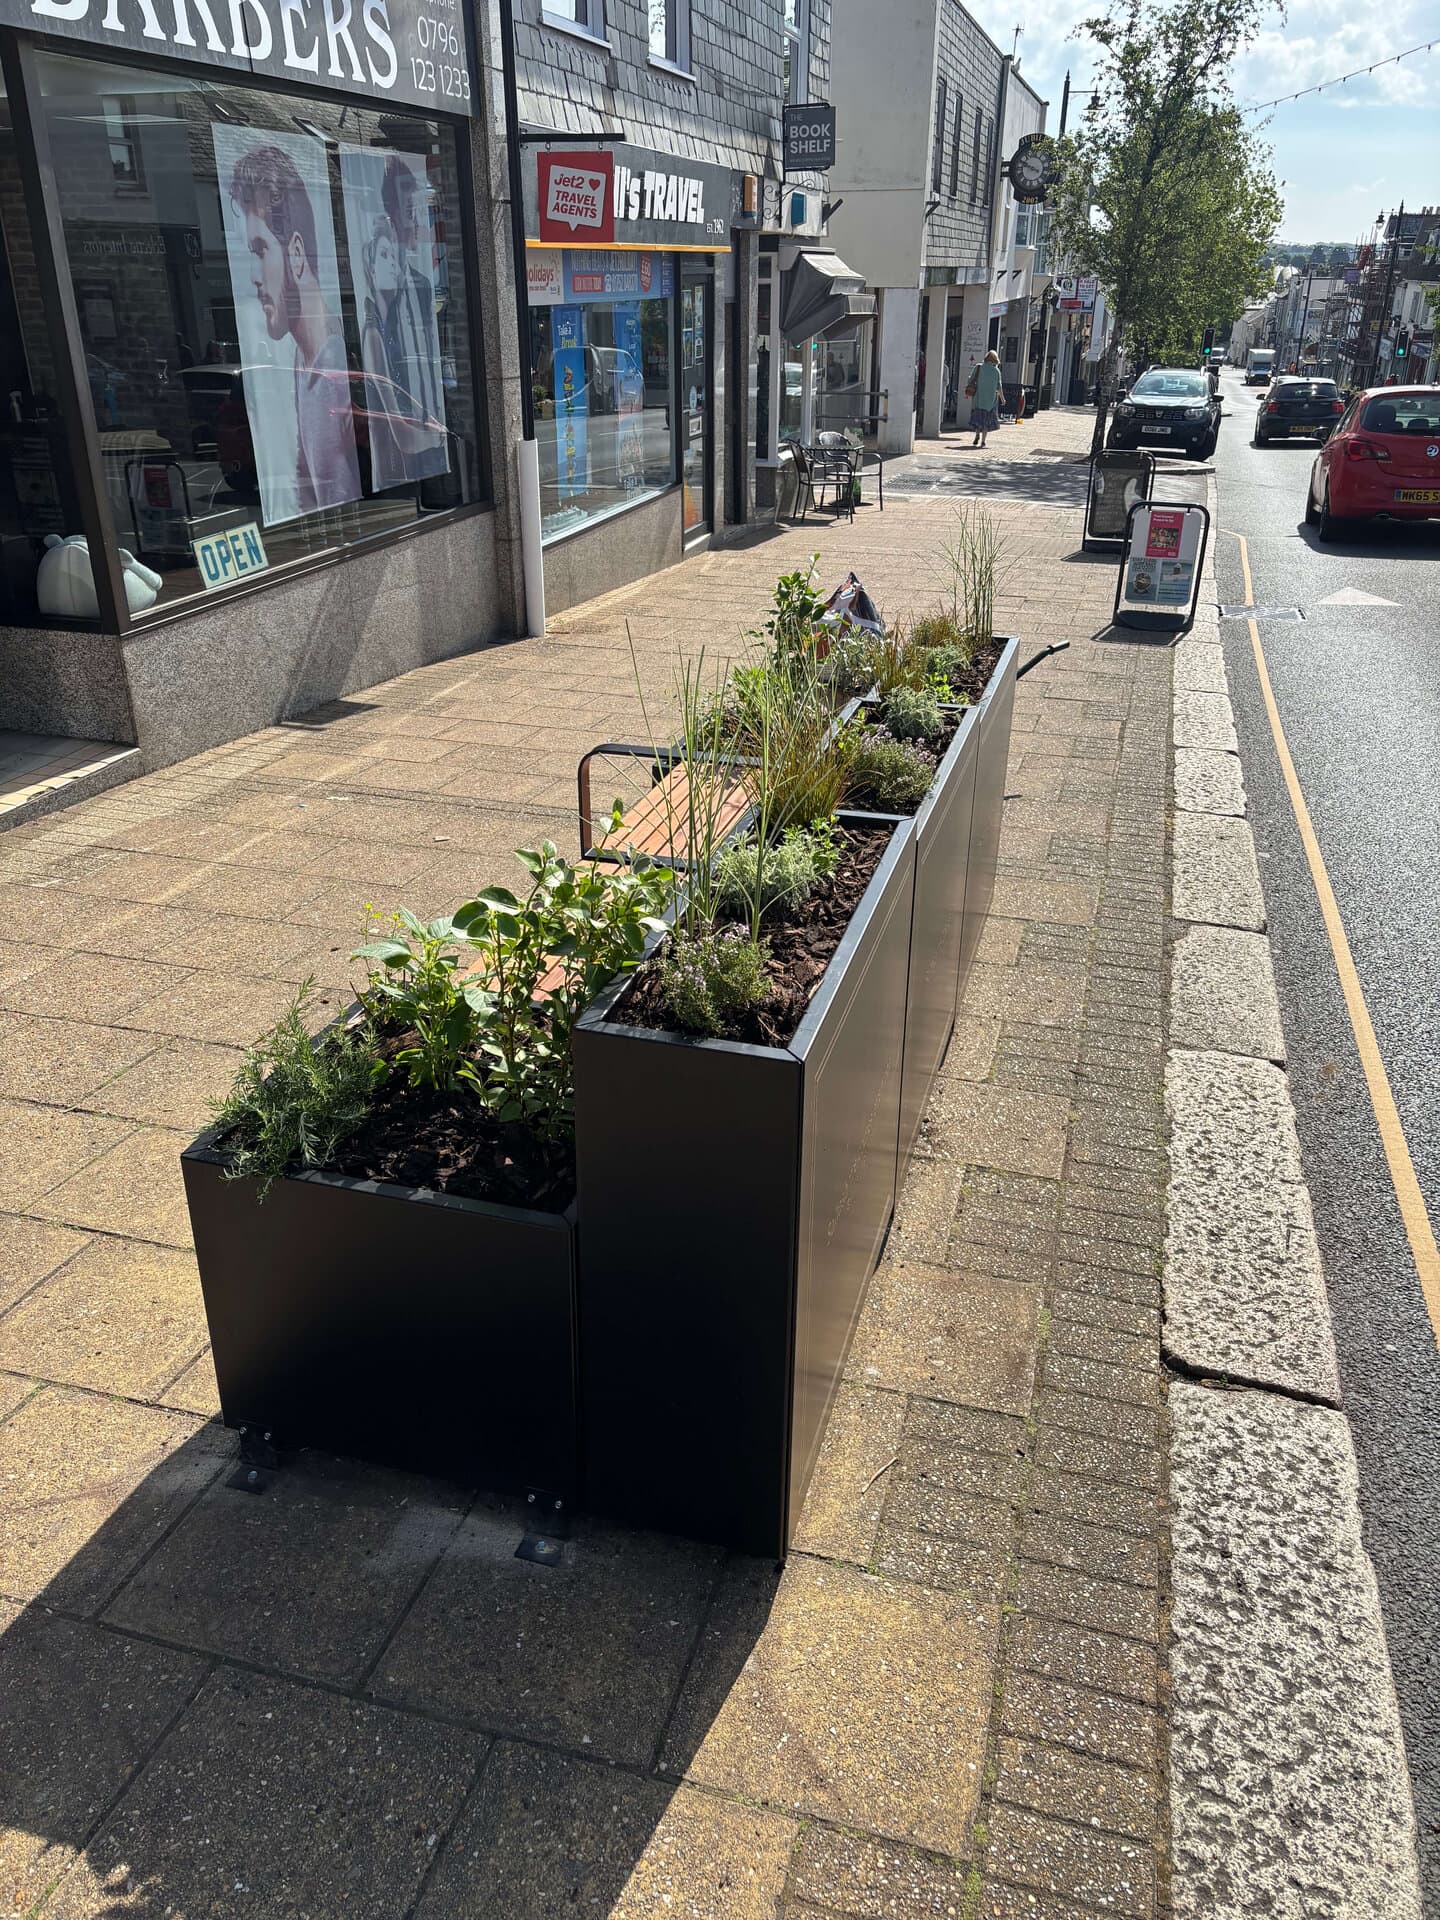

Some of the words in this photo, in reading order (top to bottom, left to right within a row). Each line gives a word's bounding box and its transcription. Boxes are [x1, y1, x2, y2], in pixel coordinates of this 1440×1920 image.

[31, 0, 398, 89] RBERS
[418, 16, 458, 56] 0796
[411, 57, 436, 92] 123
[439, 64, 471, 99] 1233
[789, 123, 831, 139] BOOK
[789, 139, 831, 154] SHELF
[552, 201, 598, 218] AGENTS
[555, 190, 597, 207] TRAVEL
[643, 170, 705, 225] TRAVEL
[528, 263, 554, 287] olidays
[200, 529, 263, 582] OPEN
